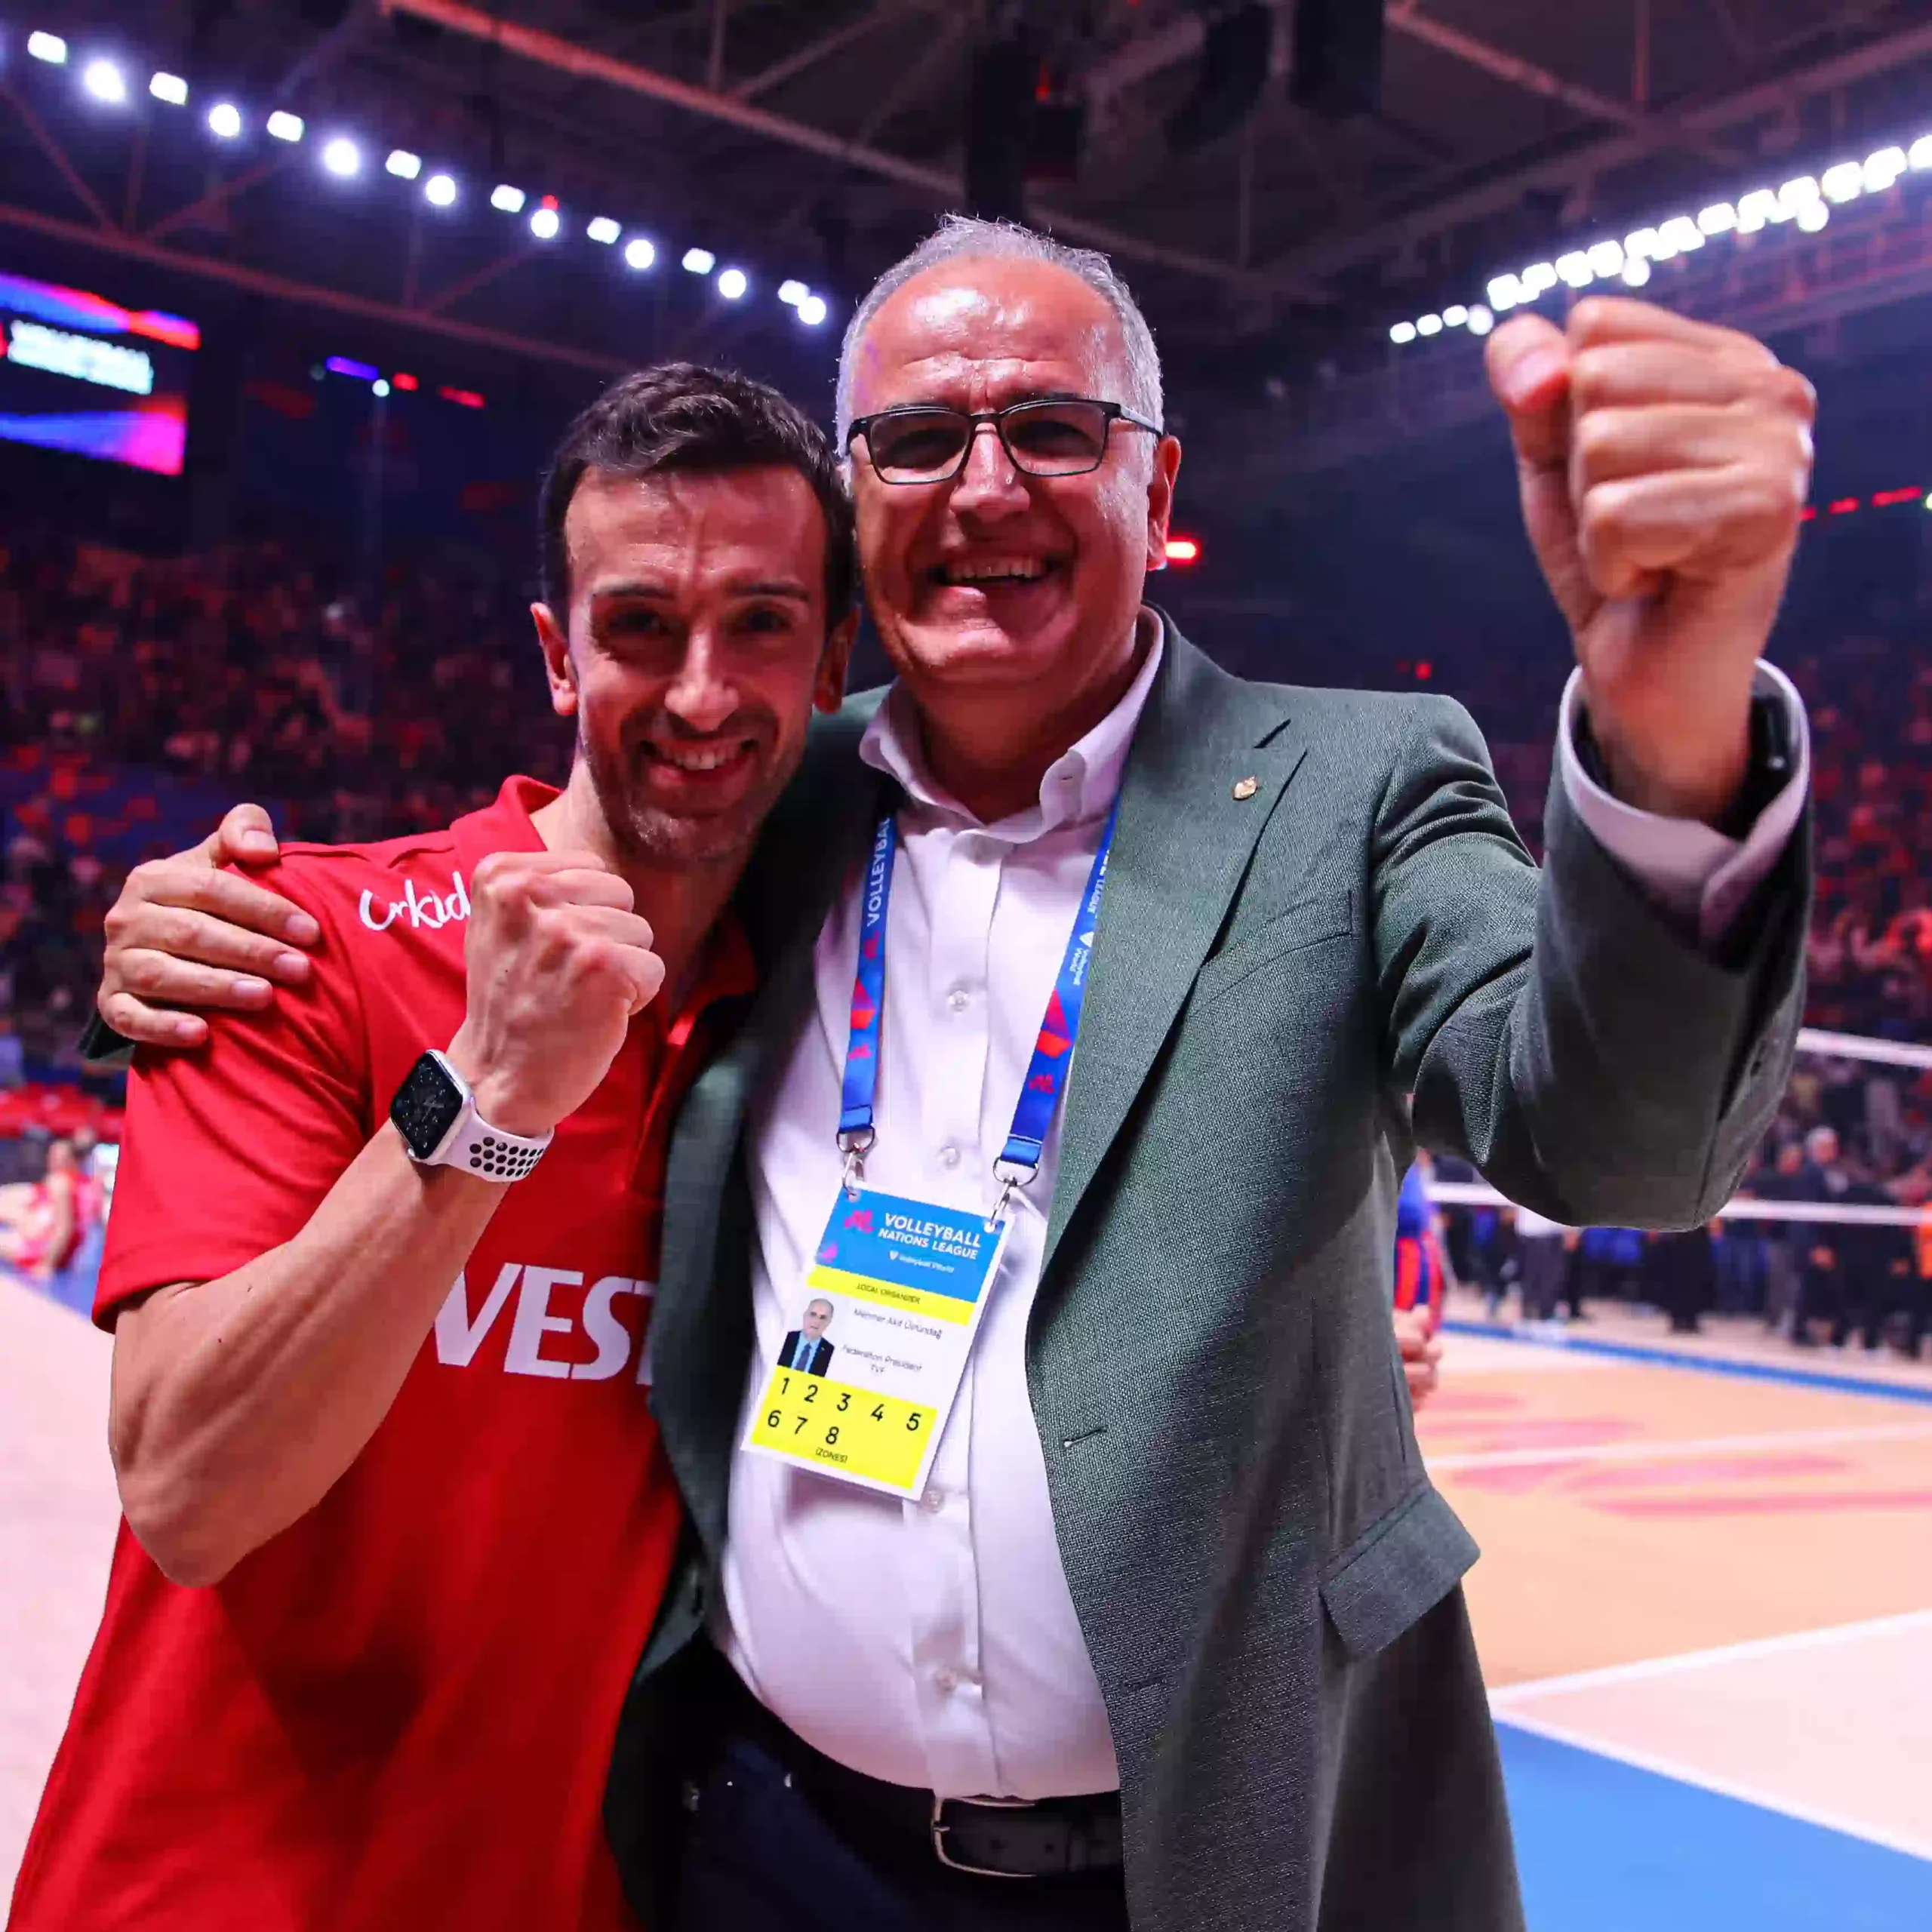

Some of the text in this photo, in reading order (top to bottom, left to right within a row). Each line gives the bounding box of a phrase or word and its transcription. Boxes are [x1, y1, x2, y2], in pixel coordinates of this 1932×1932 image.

[878, 1228, 979, 1260] NATIONS LEAGUE
[885, 1212, 981, 1247] VOLLEYBALL
[857, 1283, 878, 1294] LOCAL
[782, 1377, 921, 1431] 1 2 3 4 5
[768, 1410, 839, 1444] 6 7 8
